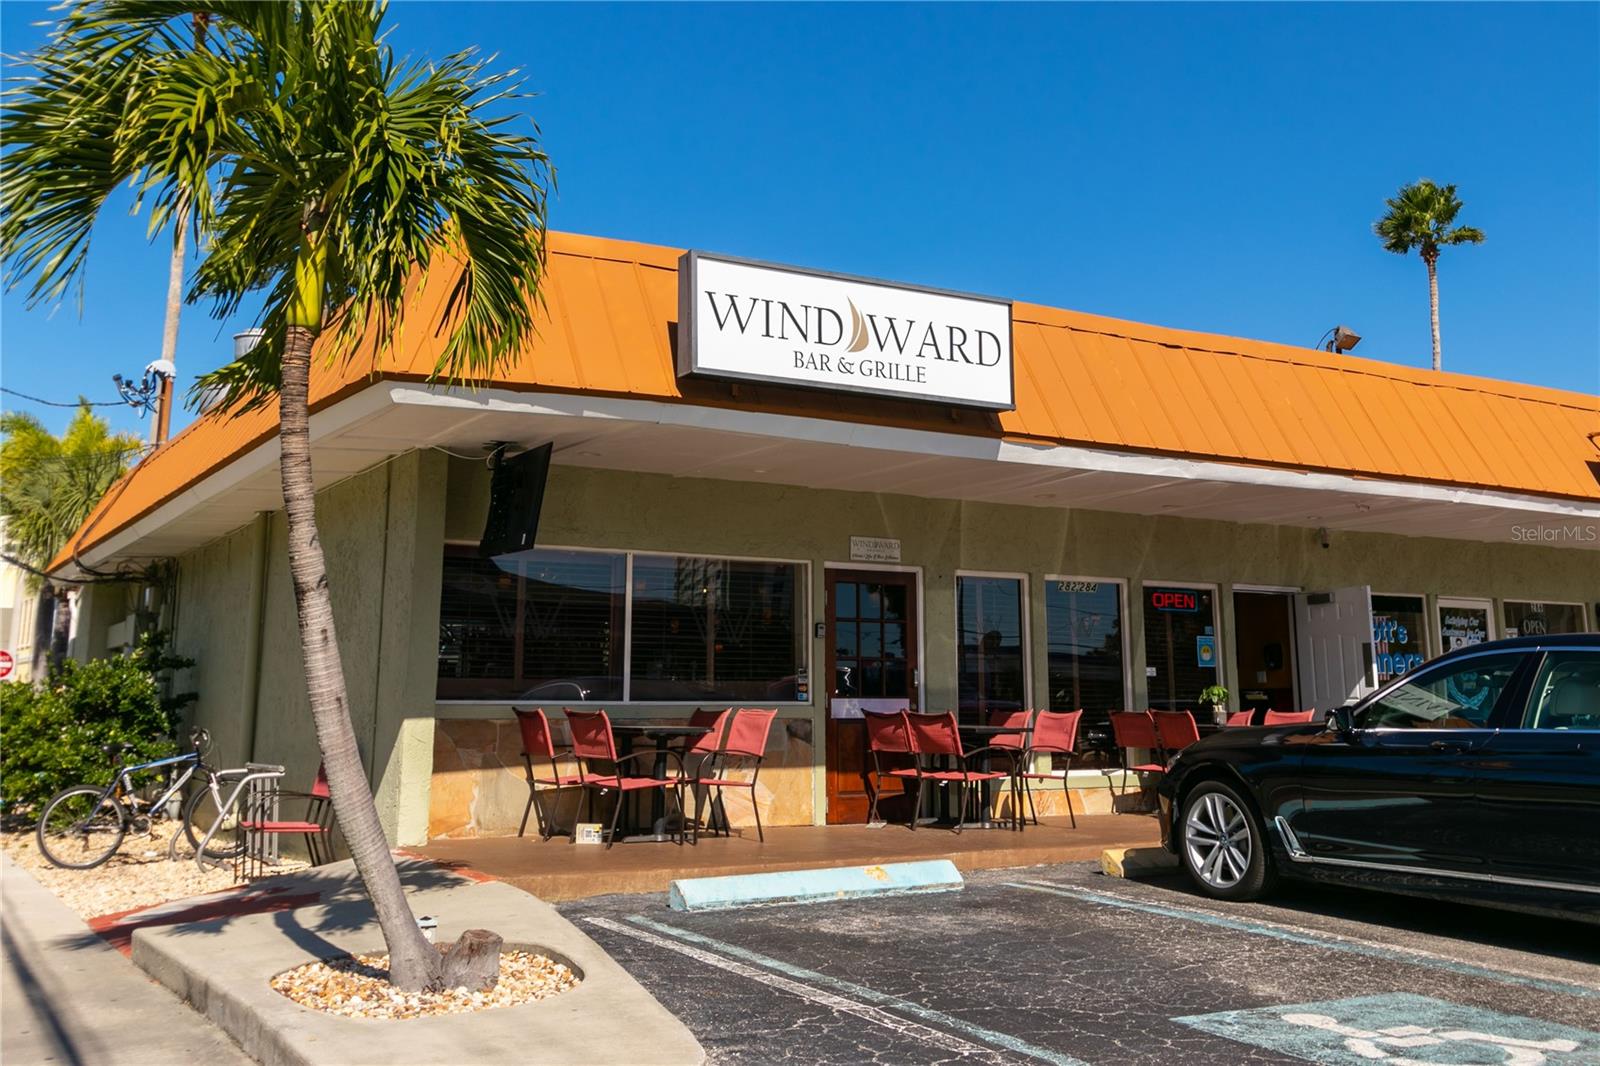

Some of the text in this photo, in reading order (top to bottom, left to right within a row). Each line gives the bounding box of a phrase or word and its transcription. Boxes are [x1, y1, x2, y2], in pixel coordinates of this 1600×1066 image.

[793, 350, 927, 383] BAR & GRILLE
[1152, 592, 1195, 609] OPEN
[1523, 619, 1547, 634] OPEN
